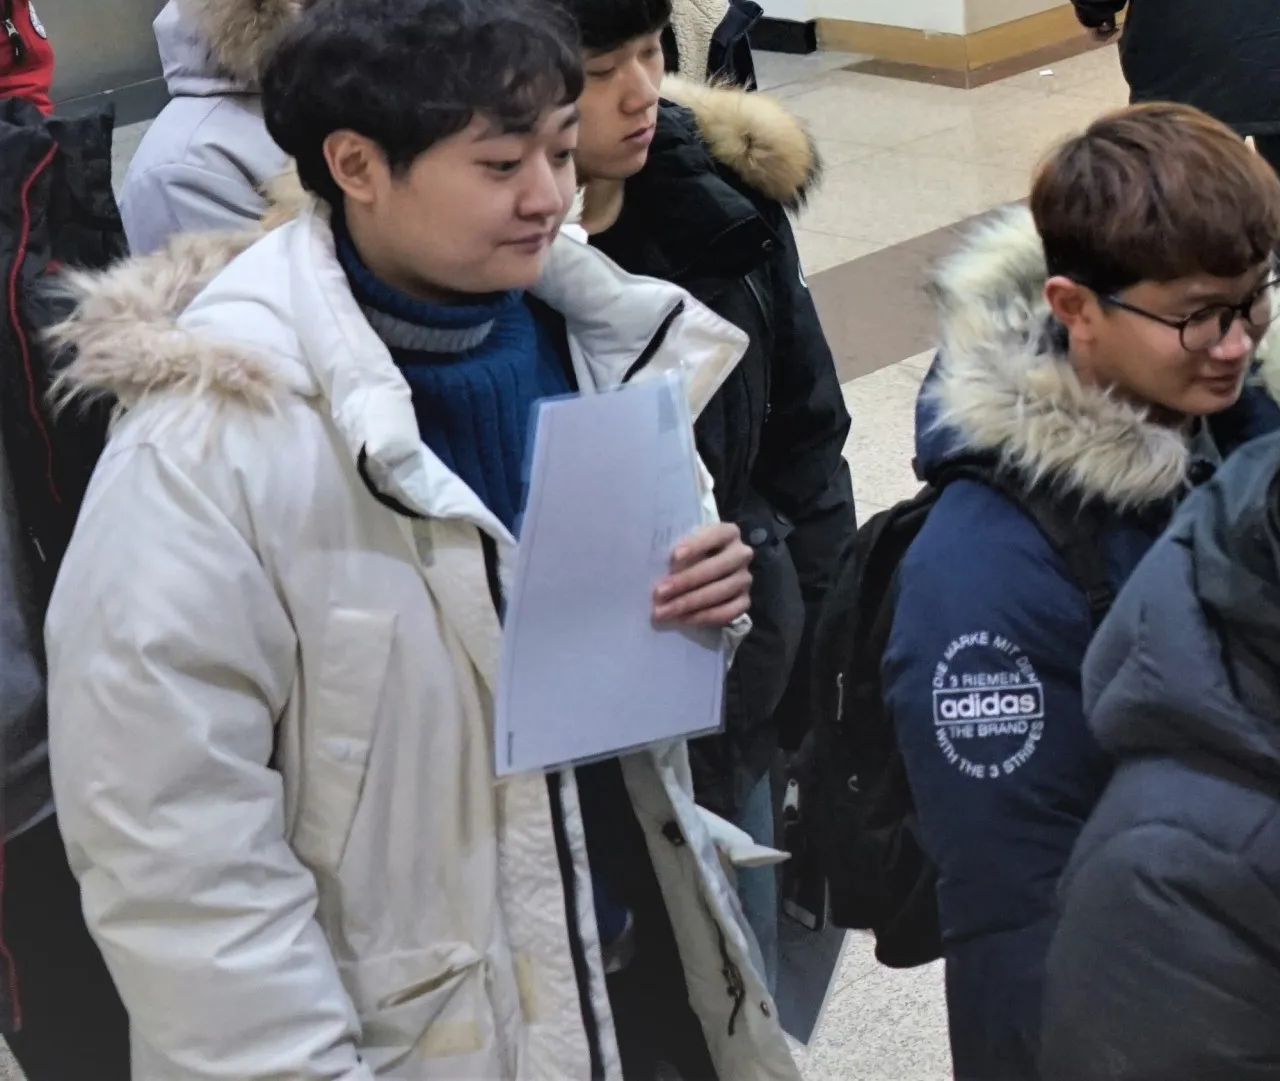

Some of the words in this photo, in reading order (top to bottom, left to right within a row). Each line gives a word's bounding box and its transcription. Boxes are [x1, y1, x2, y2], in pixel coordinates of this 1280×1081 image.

[932, 661, 948, 689] DIE
[944, 630, 989, 661] MARKE
[993, 635, 1020, 656] MIT
[1016, 656, 1038, 682] DEN
[962, 671, 1021, 687] RIEMEN
[940, 692, 1036, 719] adidas
[950, 724, 974, 739] THE
[978, 721, 1028, 737] BRAND
[936, 727, 959, 764] WITH
[959, 757, 985, 779] THE
[989, 764, 1000, 779] 3
[1002, 720, 1044, 774] STRIPES
